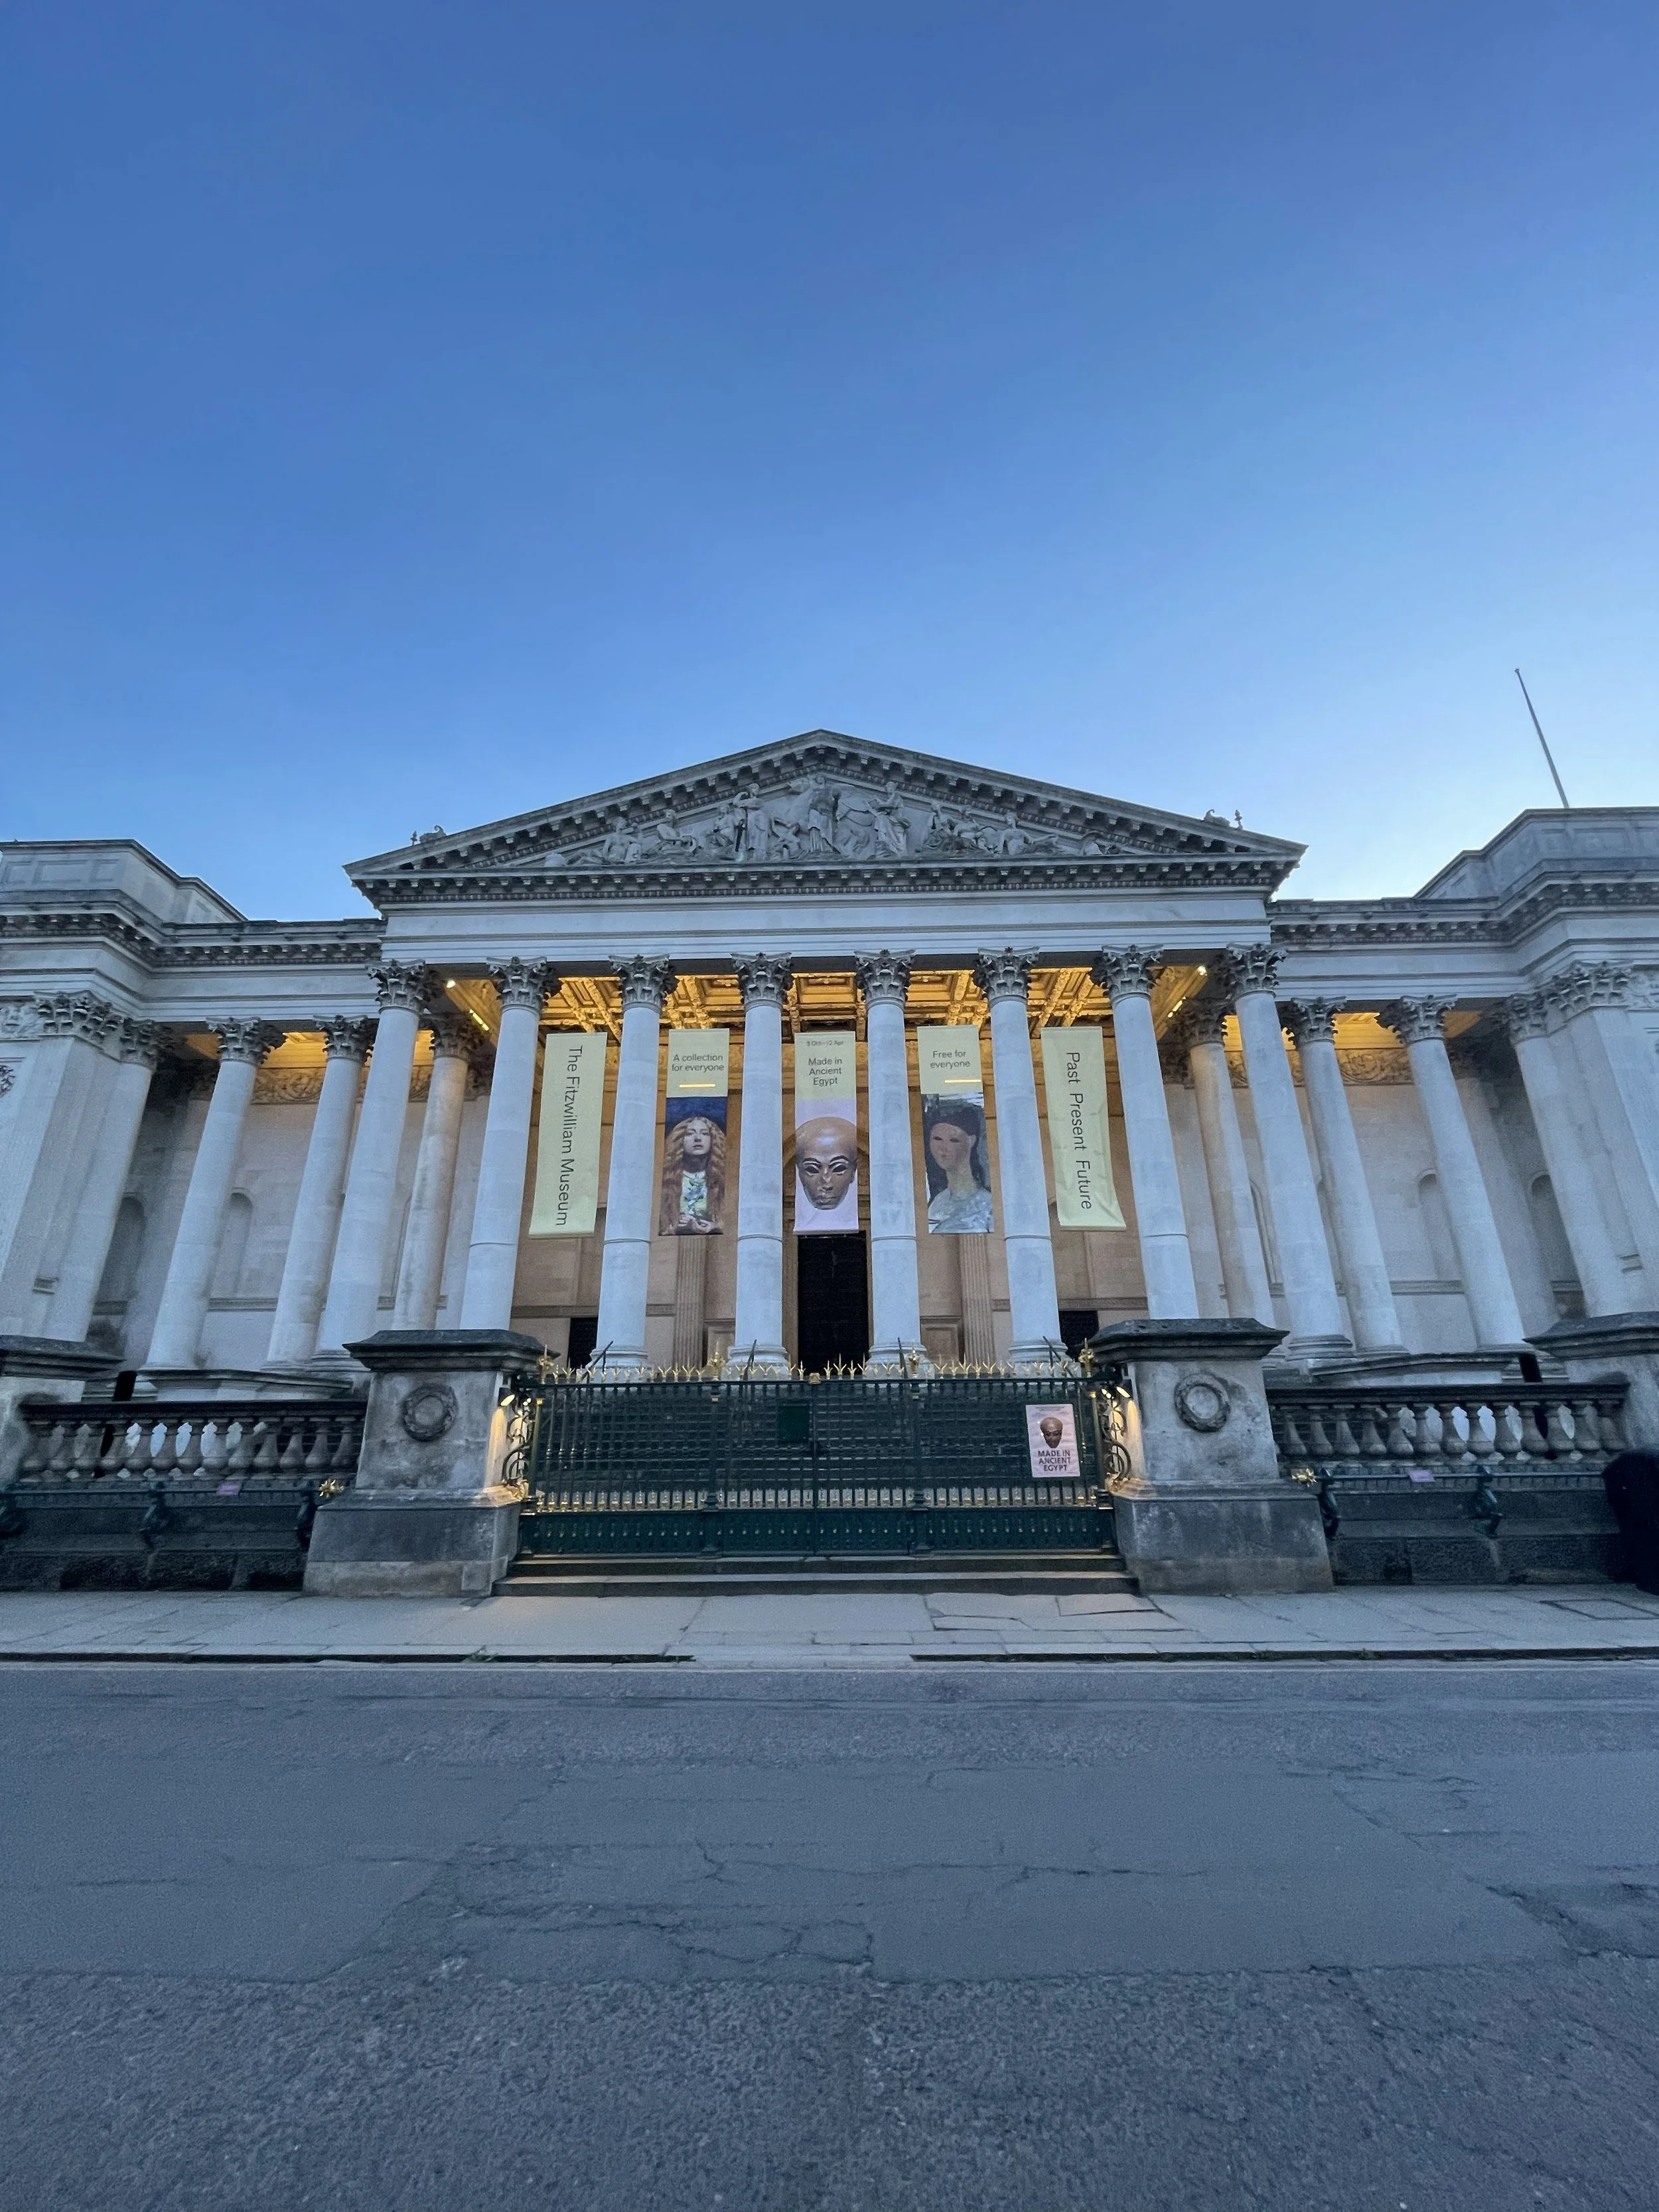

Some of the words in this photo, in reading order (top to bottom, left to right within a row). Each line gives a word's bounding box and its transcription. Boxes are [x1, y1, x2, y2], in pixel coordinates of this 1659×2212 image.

[567, 1046, 583, 1072] The
[682, 1053, 723, 1062] collection
[808, 1057, 833, 1066] Made
[835, 1057, 843, 1065] in
[930, 1061, 970, 1069] everyone
[685, 1065, 725, 1073] everyone
[808, 1067, 842, 1076] Ancient
[1066, 1052, 1080, 1084] Past
[813, 1076, 838, 1087] Egypt
[562, 1076, 580, 1154] Fitzwilliam
[1069, 1093, 1084, 1151] Present
[556, 1159, 575, 1226] Museum
[1076, 1159, 1092, 1210] Future
